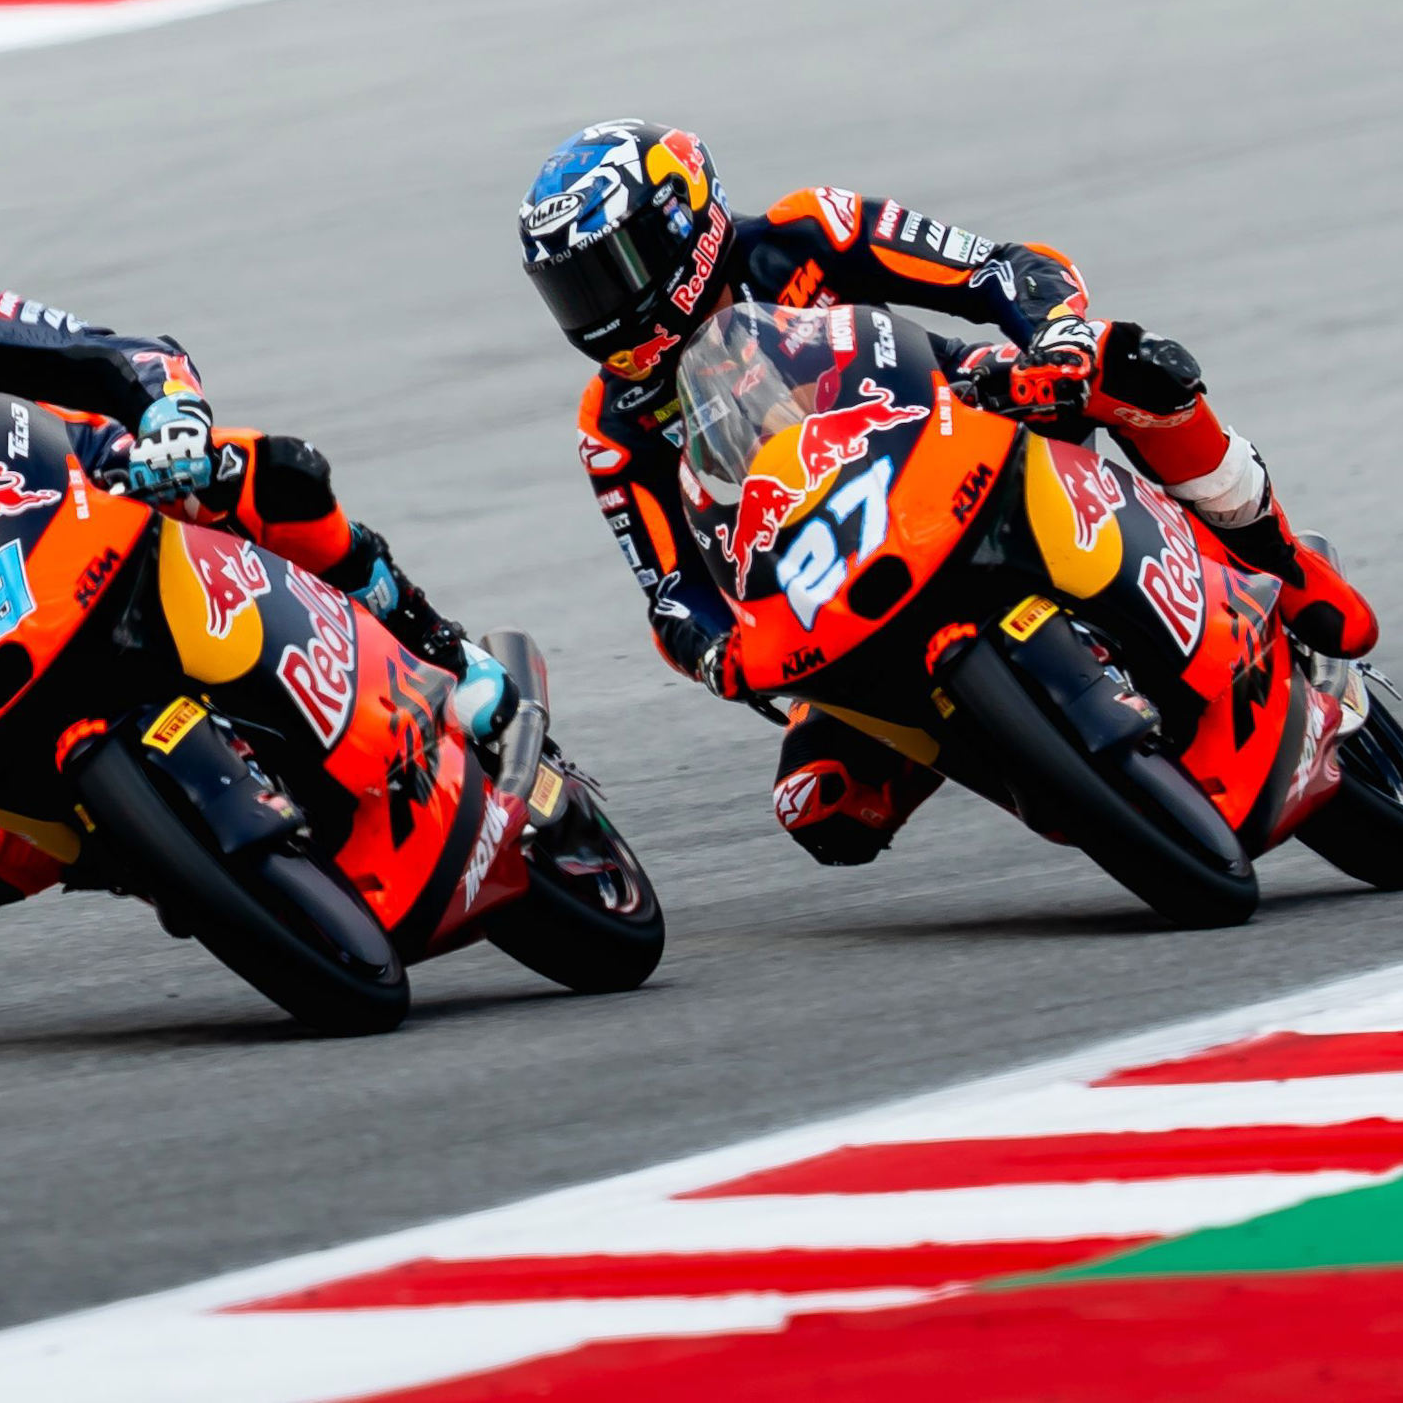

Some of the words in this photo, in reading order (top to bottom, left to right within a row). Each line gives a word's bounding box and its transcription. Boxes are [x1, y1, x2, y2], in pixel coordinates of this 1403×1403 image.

[531, 193, 574, 229] HJC
[577, 219, 622, 252] WINGS
[952, 462, 993, 524] KTM
[775, 454, 895, 632] 27
[75, 547, 120, 607] KTM
[782, 645, 826, 680] KTM
